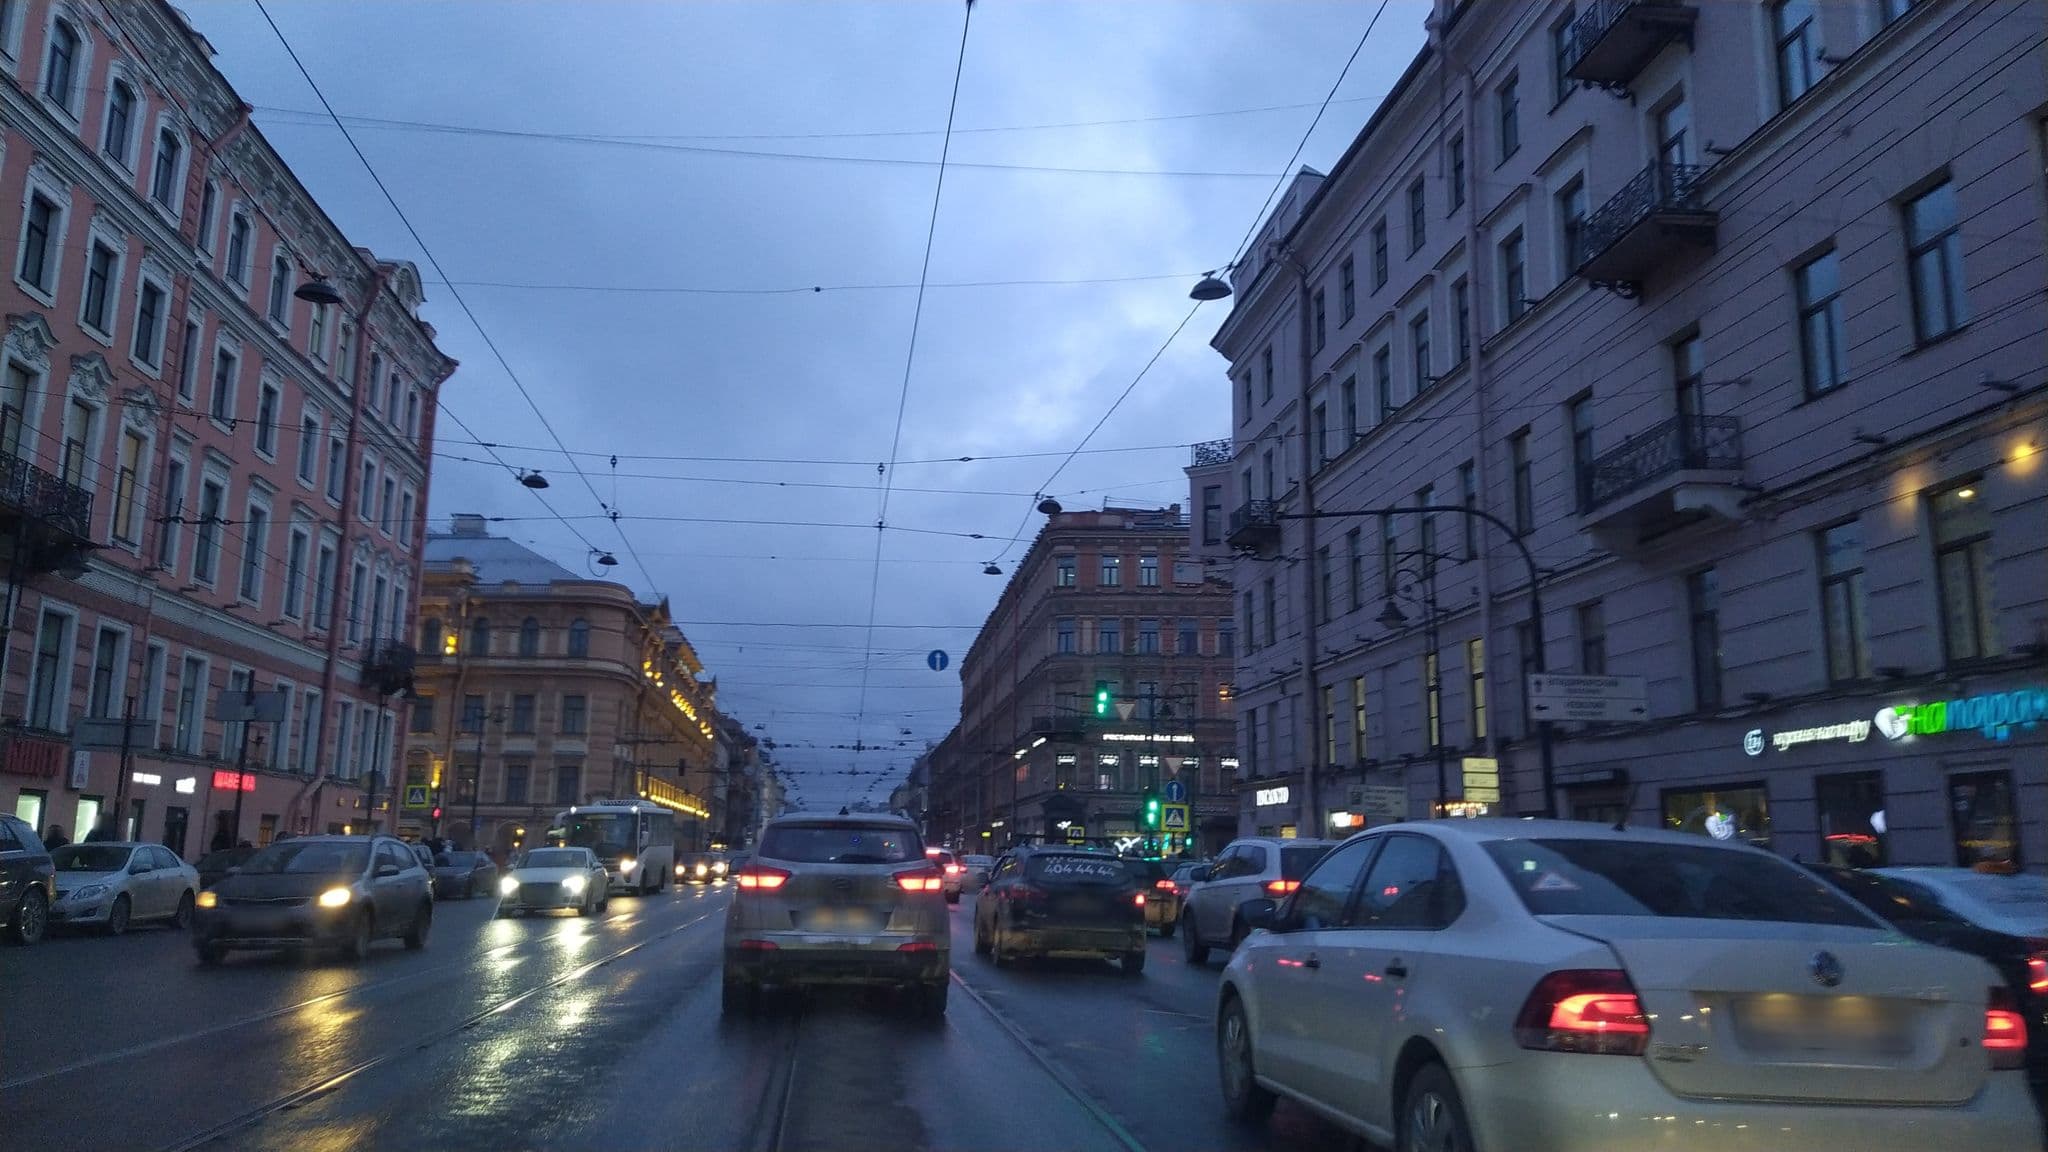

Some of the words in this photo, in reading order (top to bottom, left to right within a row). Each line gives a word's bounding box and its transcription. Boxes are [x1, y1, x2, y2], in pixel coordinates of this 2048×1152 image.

[1044, 863, 1073, 874] 404
[1075, 864, 1095, 875] 44
[1096, 866, 1116, 877] 44
